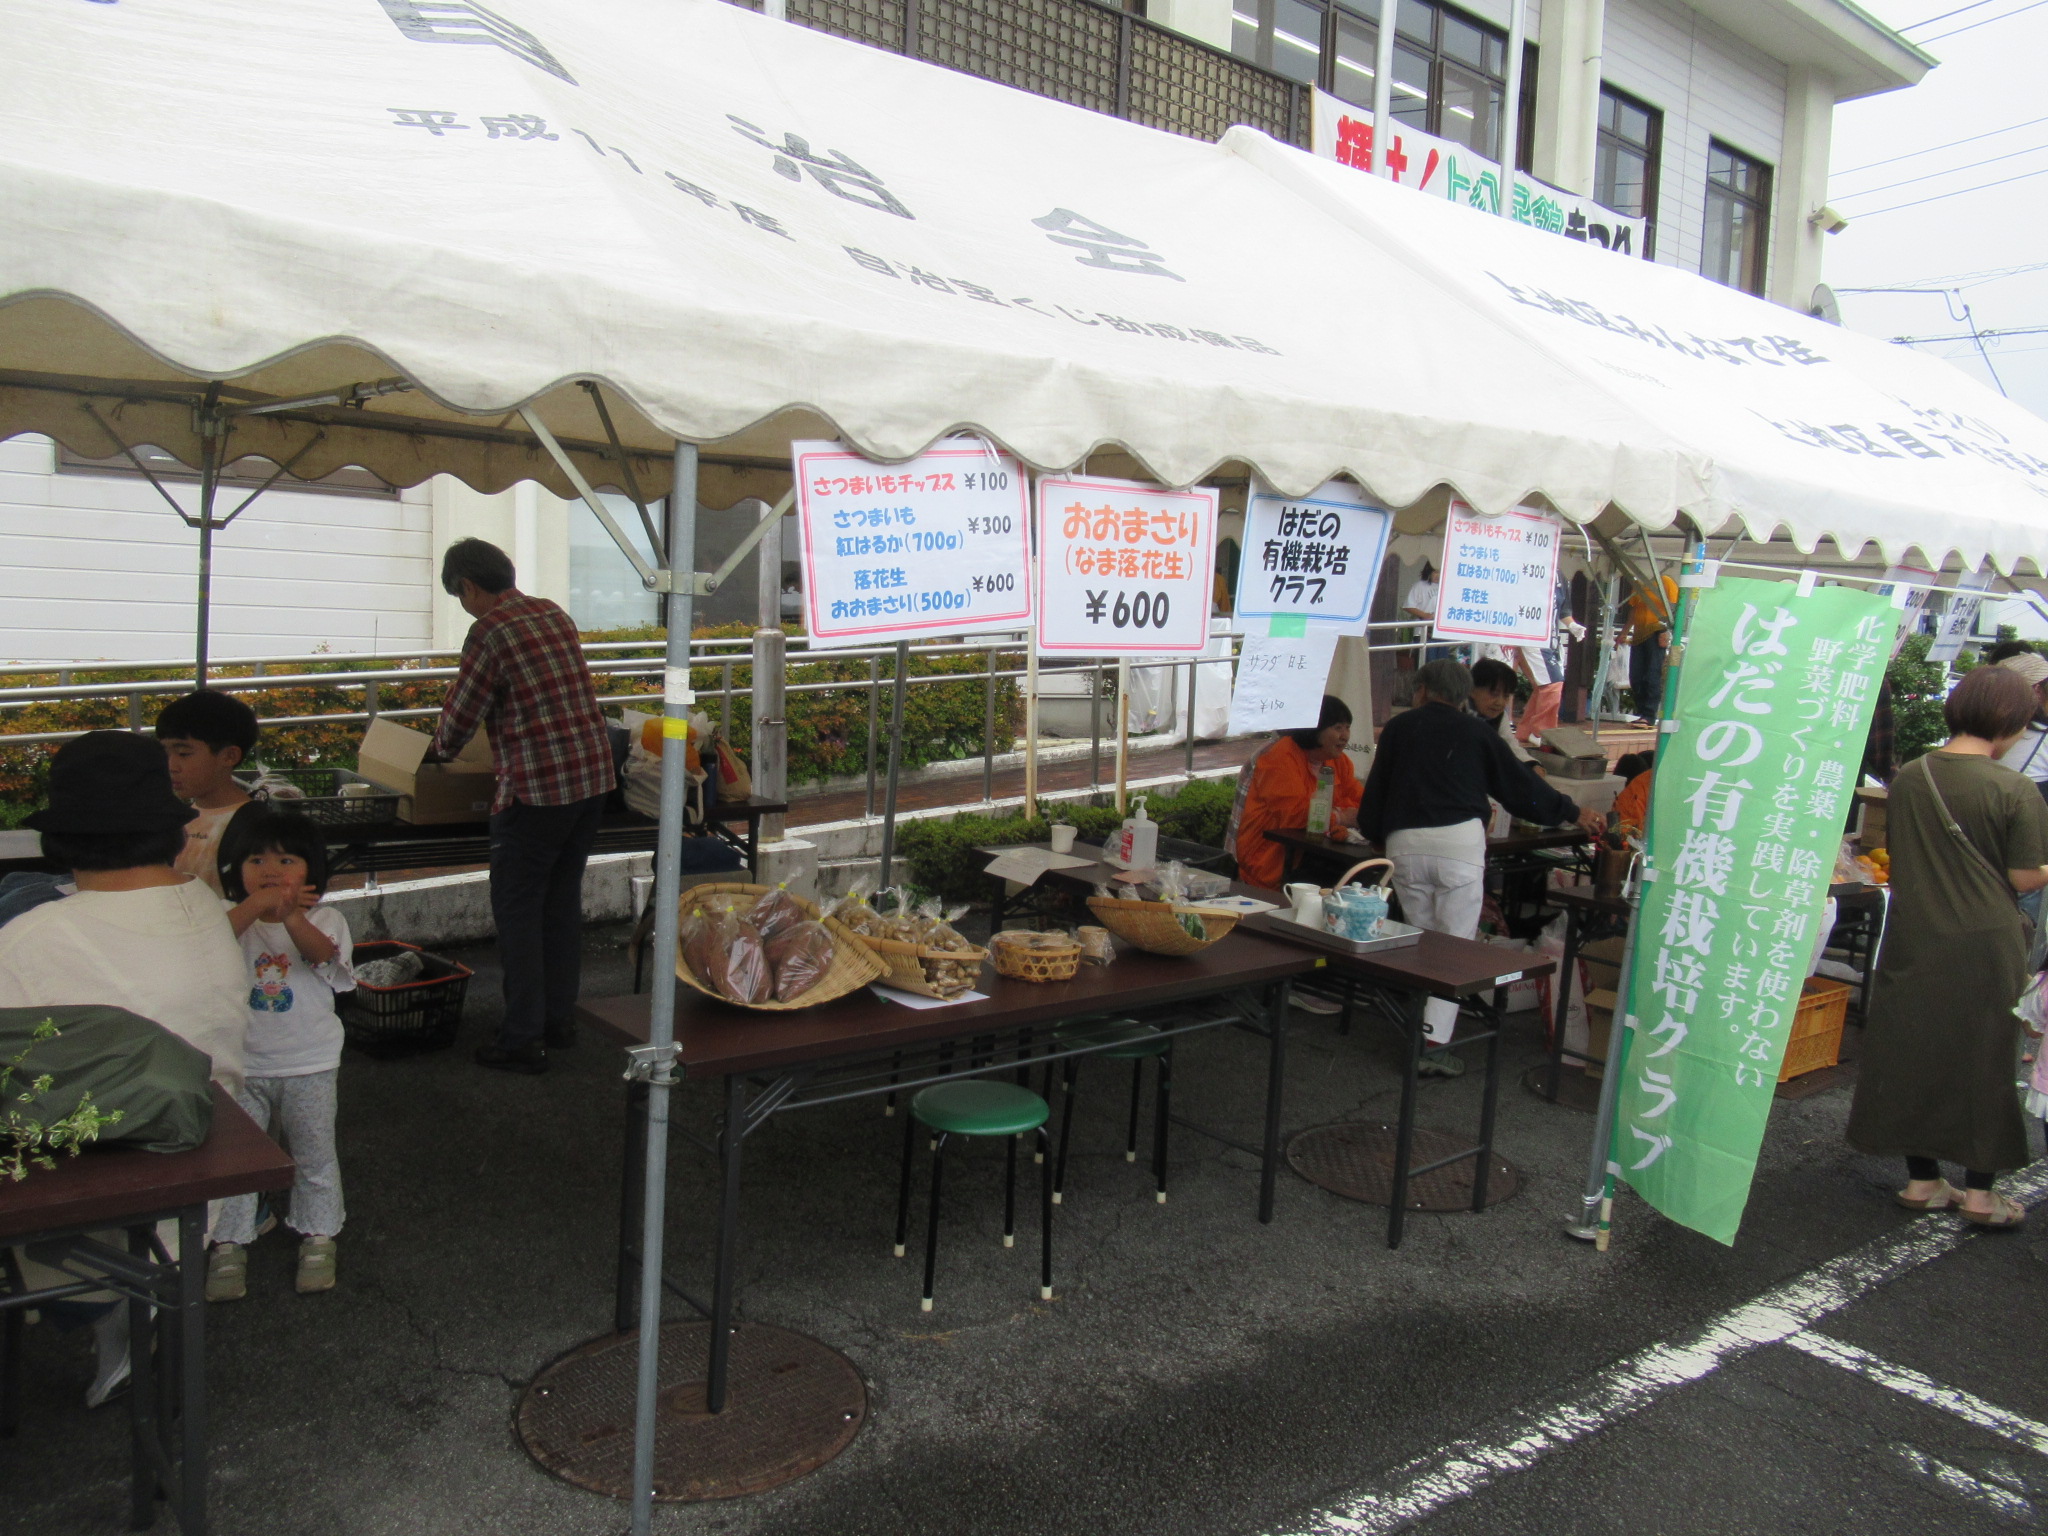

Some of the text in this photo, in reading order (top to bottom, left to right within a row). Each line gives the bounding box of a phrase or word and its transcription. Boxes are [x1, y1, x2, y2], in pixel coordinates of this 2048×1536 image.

[813, 472, 1008, 496] さつまいもチップス ¥100
[833, 507, 916, 528] さつまいも
[836, 515, 1011, 557] 紅はるか(700g) ¥300
[1063, 501, 1199, 547] おおまさり
[1277, 506, 1341, 540] はだの
[1065, 544, 1193, 581] (なま落花生)
[1262, 539, 1350, 576] 有機栽培
[831, 573, 1014, 619] おおまさり(500g) ¥600
[854, 567, 907, 590] 落花生
[1268, 574, 1328, 605] クラブ
[1085, 589, 1170, 629] ¥600
[1716, 636, 1845, 1034] 野菜づくりを実践しています。
[1630, 602, 1799, 1171] はだの有機栽培クラブ
